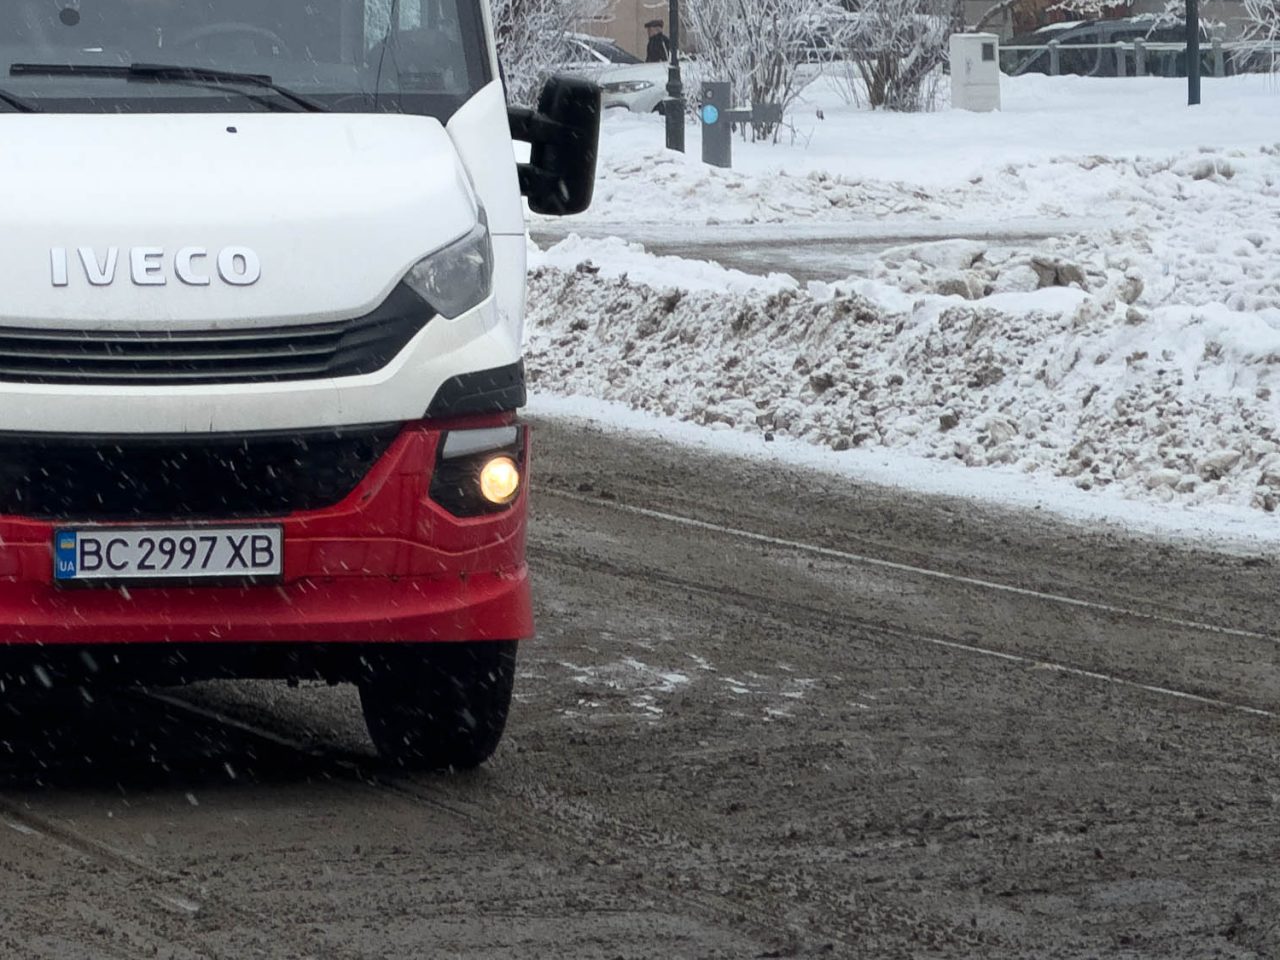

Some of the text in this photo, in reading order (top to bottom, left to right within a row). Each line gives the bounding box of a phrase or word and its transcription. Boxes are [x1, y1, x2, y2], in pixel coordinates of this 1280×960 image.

[50, 246, 261, 287] IVECO
[58, 560, 75, 572] UA
[79, 534, 275, 571] BC 2997 XB
